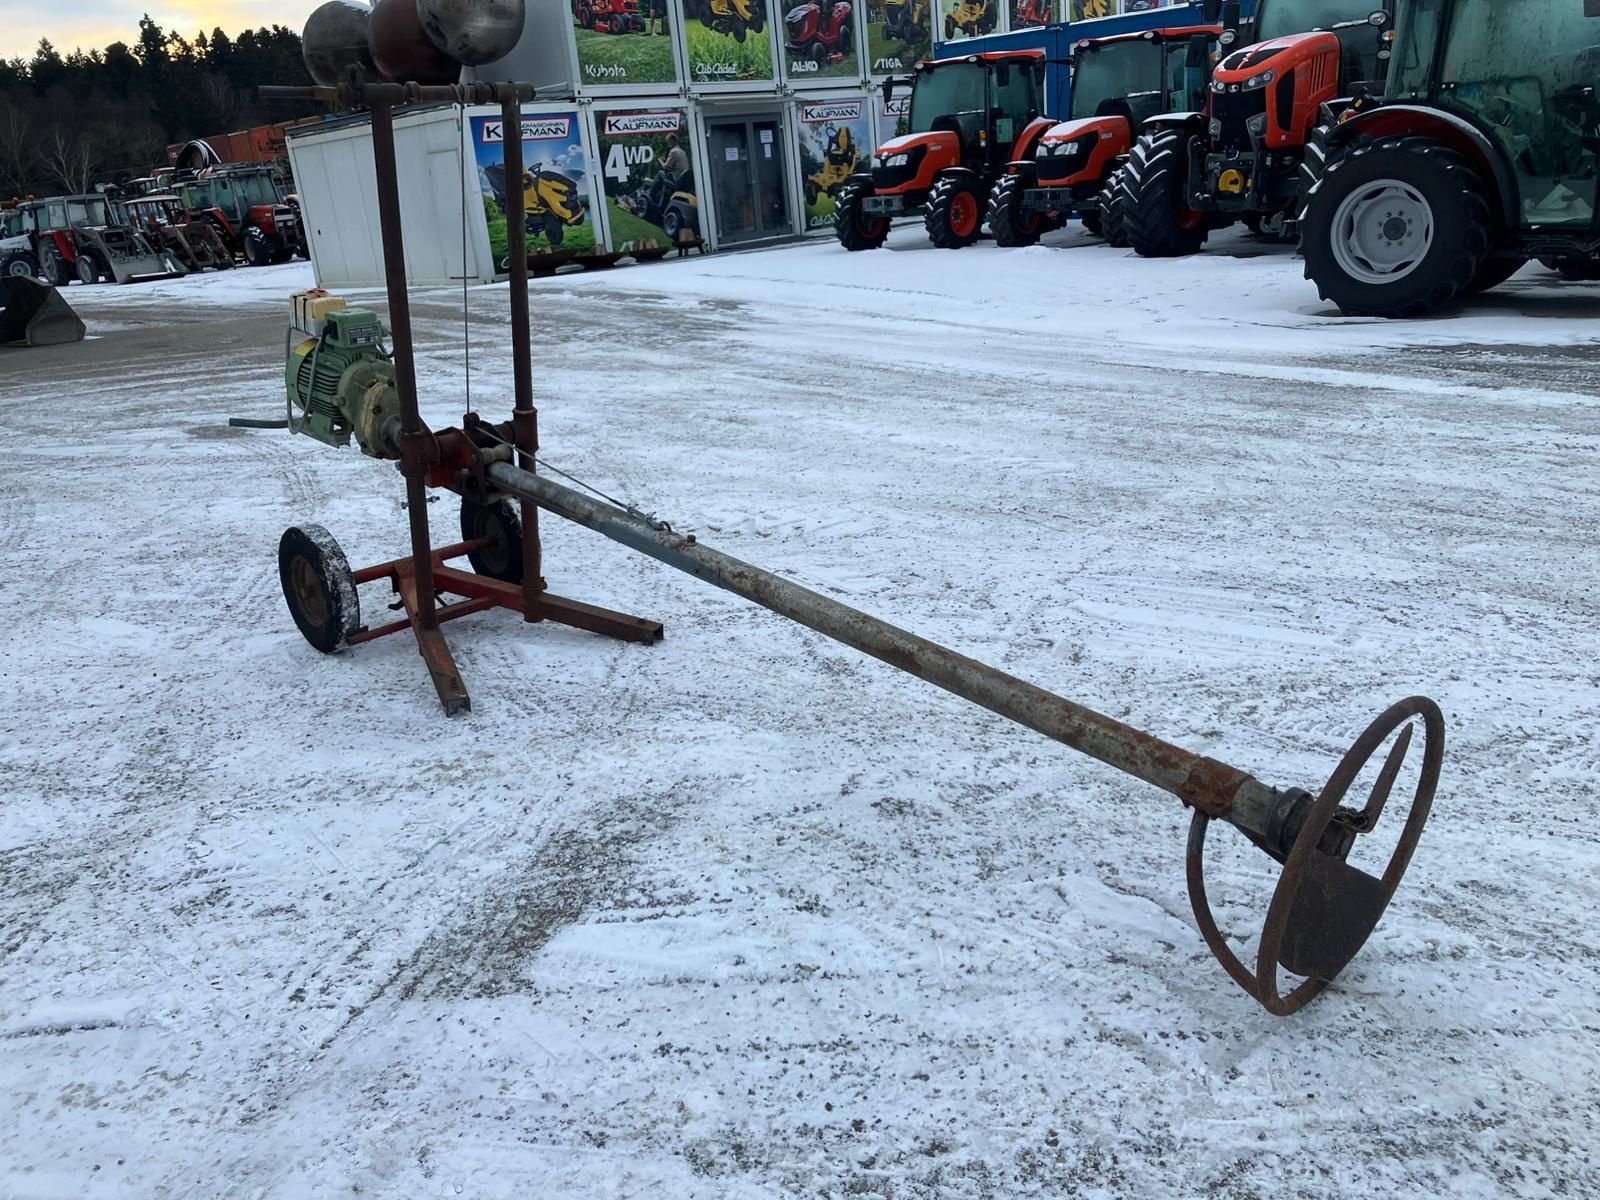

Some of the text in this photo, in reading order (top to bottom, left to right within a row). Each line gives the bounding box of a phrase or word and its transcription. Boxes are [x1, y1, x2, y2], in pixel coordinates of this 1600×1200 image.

[586, 64, 626, 77] Kubota
[695, 62, 738, 75] Cub Cadet
[792, 60, 818, 72] AL-KO
[805, 108, 858, 119] KAUFMANN
[486, 125, 566, 138] KFMANN
[608, 119, 677, 131] KAUFMANN
[605, 144, 654, 183] 4WD
